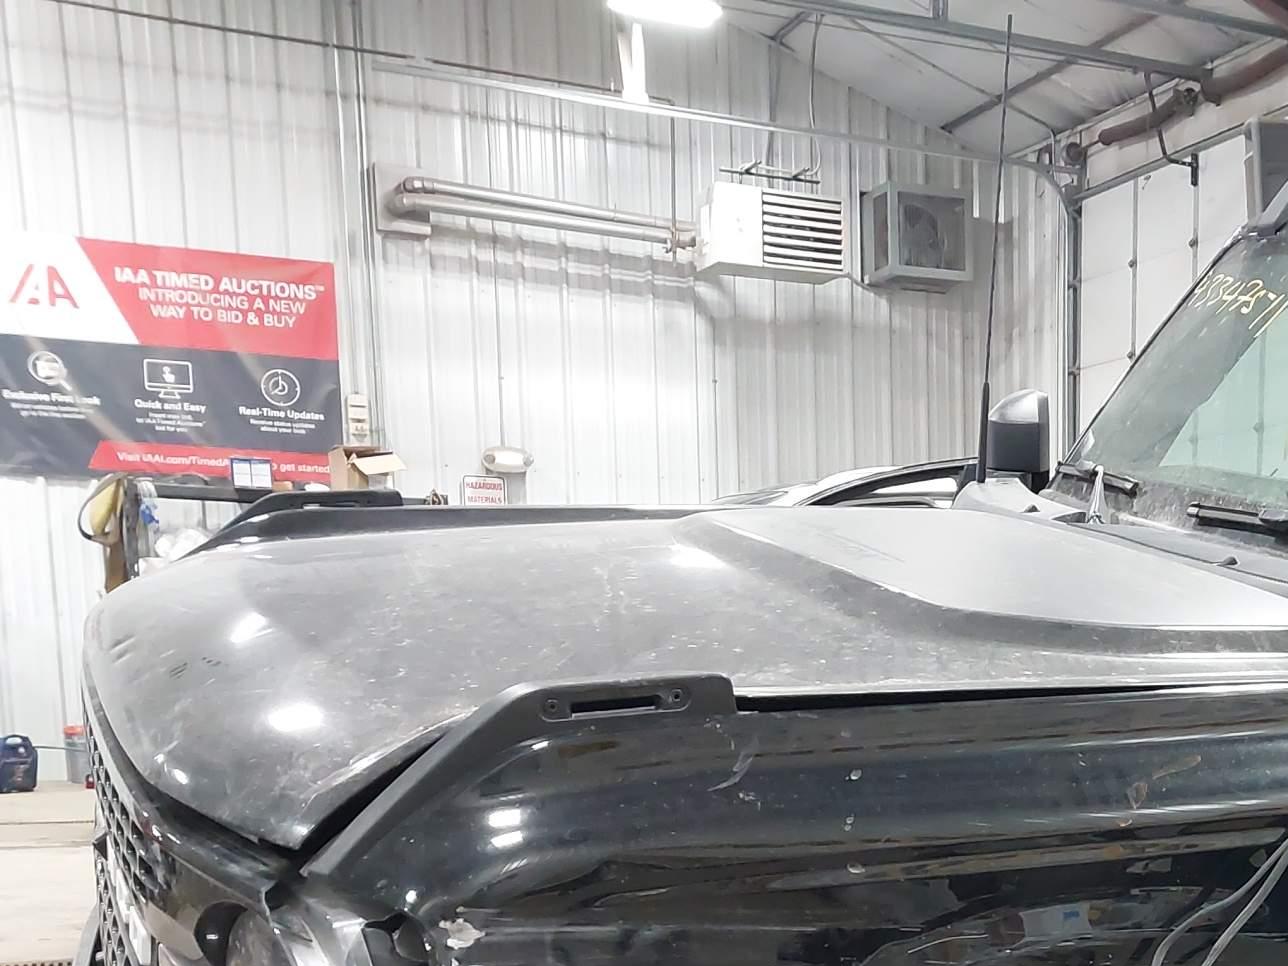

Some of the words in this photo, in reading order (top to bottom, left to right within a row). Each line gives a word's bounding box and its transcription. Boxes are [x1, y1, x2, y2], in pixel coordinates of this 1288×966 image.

[114, 266, 149, 285] IAA
[151, 270, 214, 291] TIMED
[138, 287, 249, 309] INTRODUCING
[253, 298, 267, 311] A
[269, 300, 306, 315] NEW
[151, 304, 187, 319] WAY
[190, 306, 213, 321] TO
[217, 309, 242, 324] BID
[246, 312, 259, 326] &
[263, 314, 296, 328] BUY
[134, 398, 162, 411] Quick
[163, 402, 182, 411] and
[183, 403, 206, 414] Easy
[238, 406, 285, 418] Real-Time
[287, 408, 325, 421] Updates
[280, 464, 296, 474] get
